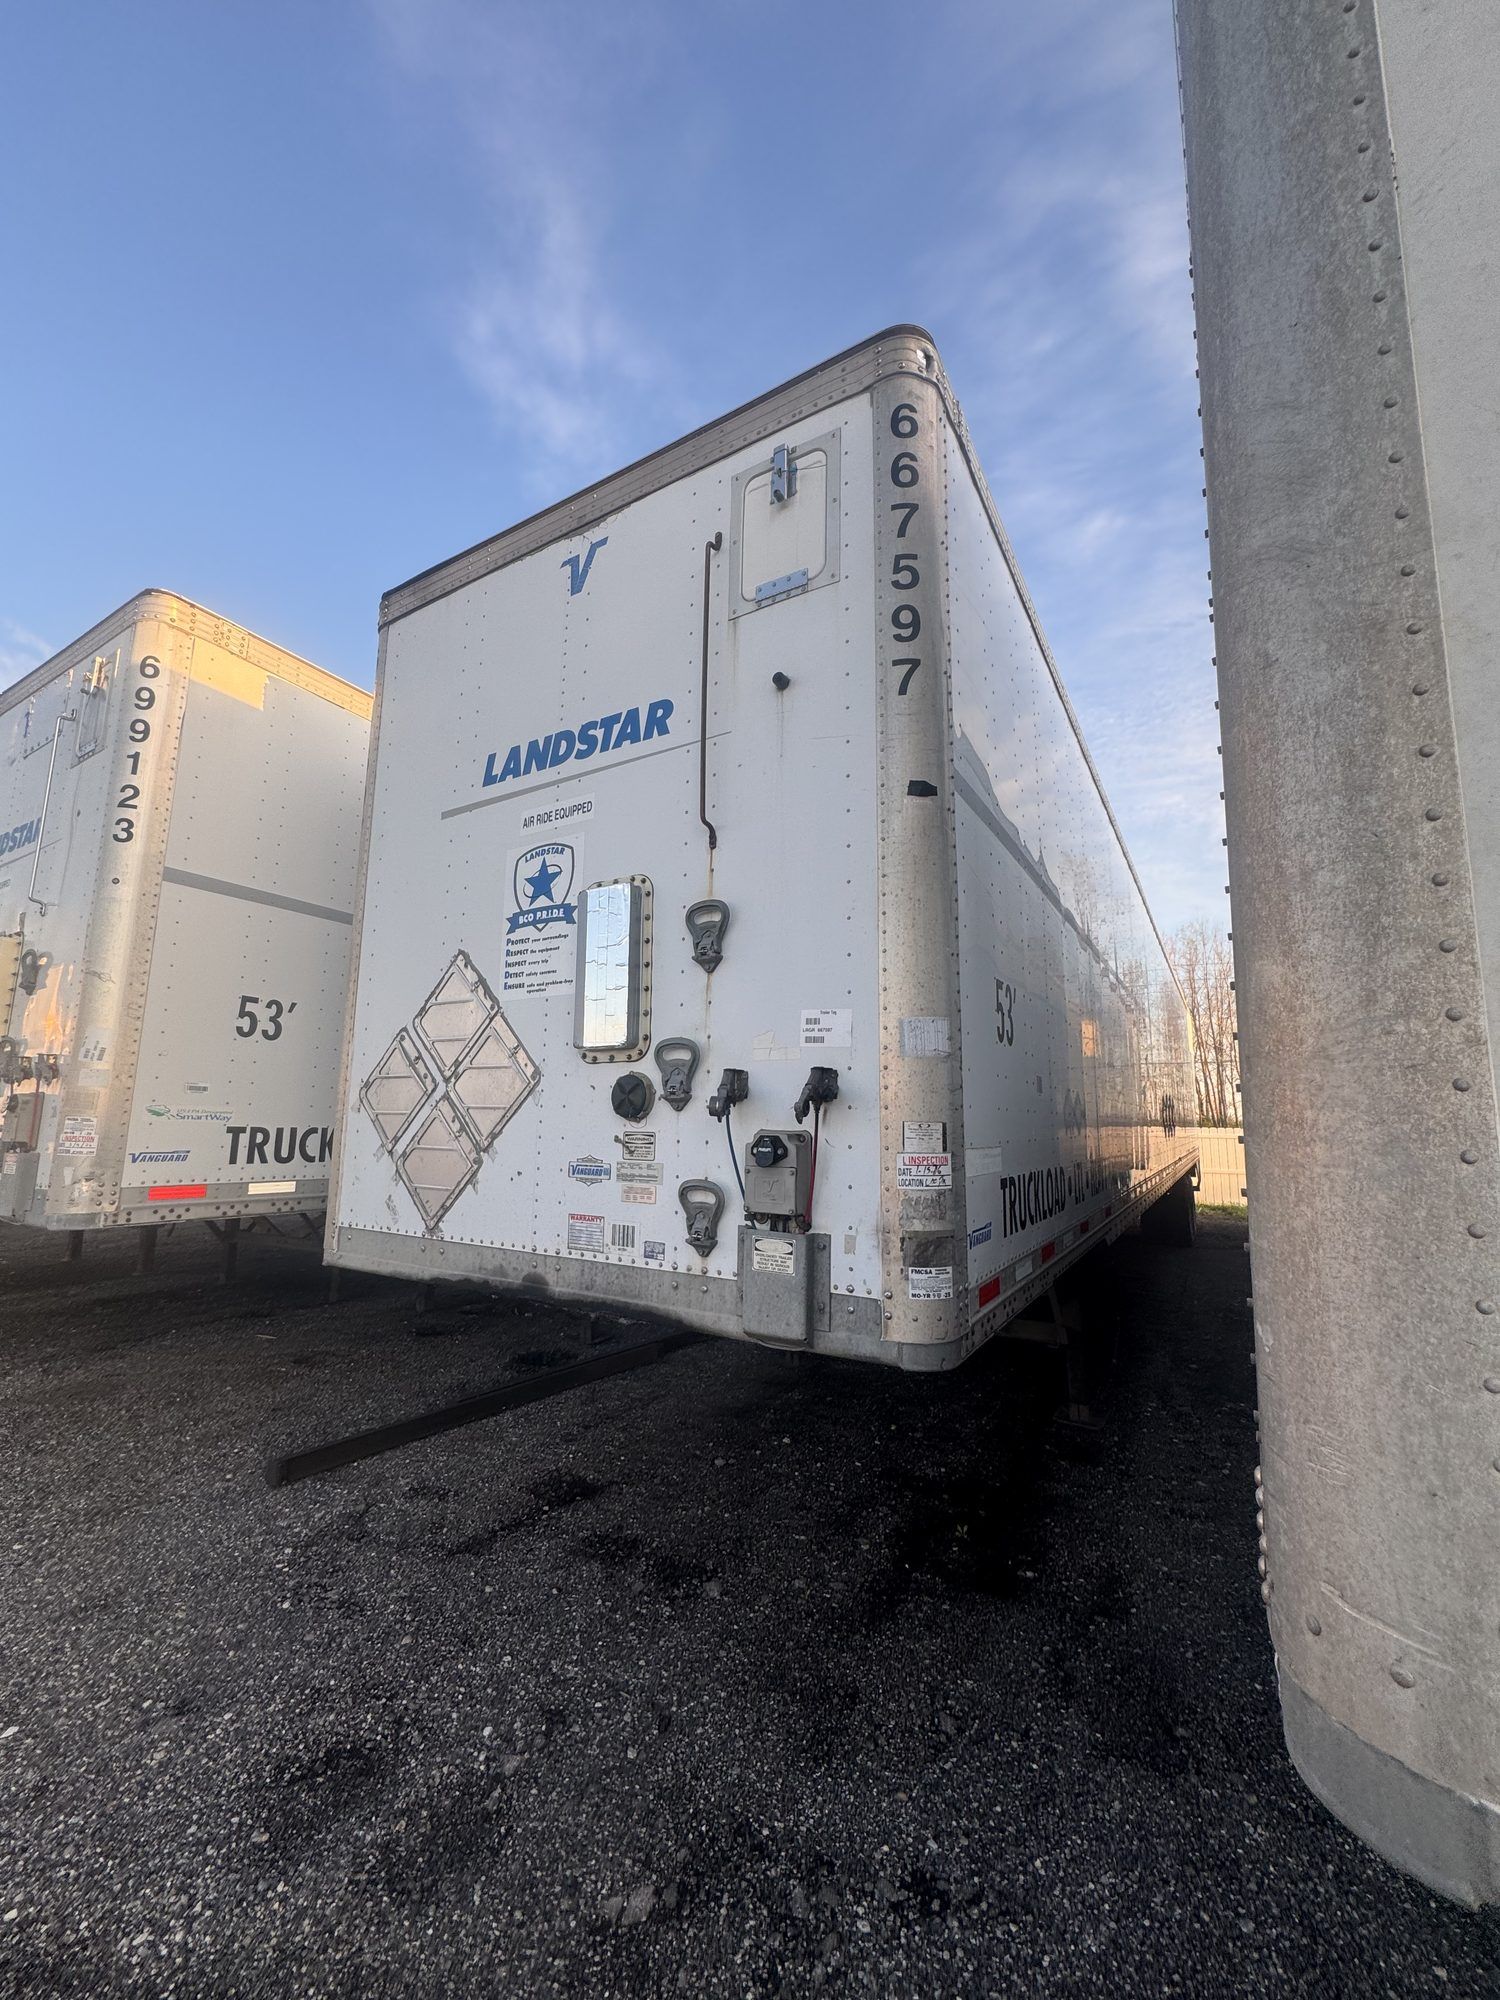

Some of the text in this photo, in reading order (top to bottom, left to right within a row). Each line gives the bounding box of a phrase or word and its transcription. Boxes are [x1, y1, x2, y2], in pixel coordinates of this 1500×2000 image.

[890, 403, 921, 696] 667597
[482, 699, 674, 787] LANDSTAR
[112, 655, 161, 843] 699123
[522, 800, 592, 828] AIR RIDE EQUIPPED
[525, 847, 565, 863] LANDSTAR
[518, 914, 534, 924] BCO
[506, 938, 530, 946] PROTECT
[506, 949, 528, 957] RESPECT
[505, 960, 527, 968] INSPECT
[505, 971, 524, 979] DETECT
[504, 982, 525, 990] ENSURE
[176, 1113, 232, 1122] SmartWay
[128, 1150, 191, 1164] VANGUARD
[908, 1156, 948, 1165] INSPECTION
[570, 1164, 604, 1176] VANGUARD
[898, 1168, 912, 1176] DATE
[898, 1179, 923, 1187] LOCATION
[1001, 1166, 1066, 1238] TRUCKLOAD
[570, 1215, 602, 1223] WARRANTY
[967, 1221, 992, 1250] VANGUARD
